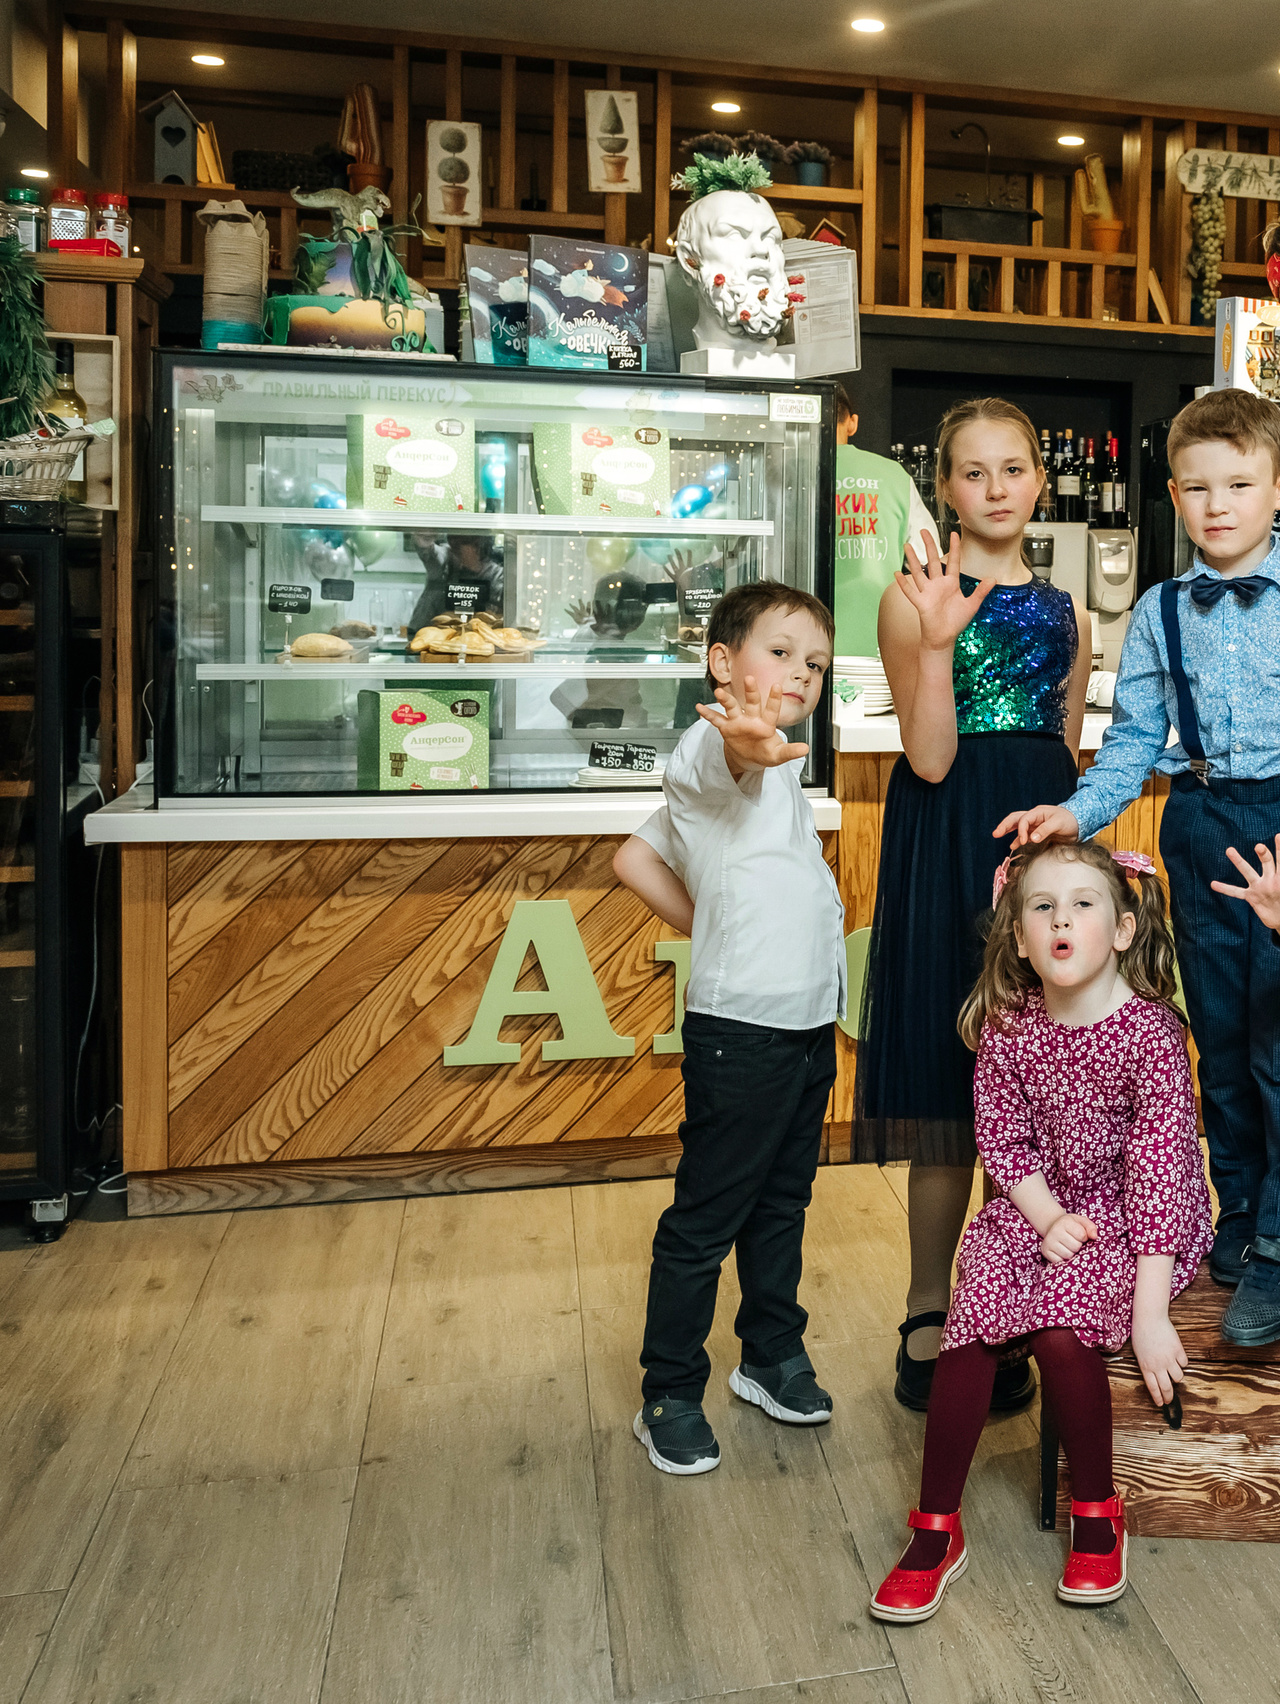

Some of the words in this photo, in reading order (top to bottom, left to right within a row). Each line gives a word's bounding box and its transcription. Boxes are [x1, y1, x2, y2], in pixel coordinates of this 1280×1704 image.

[262, 379, 372, 401] ПРАВИЛЬНЫЙ
[377, 385, 447, 404] ПЕРЕКУС
[836, 492, 880, 516] КИХ
[838, 516, 879, 537] ЛЫХ
[835, 536, 889, 562] СТВУЕТ;)
[410, 735, 465, 746] АндерСон
